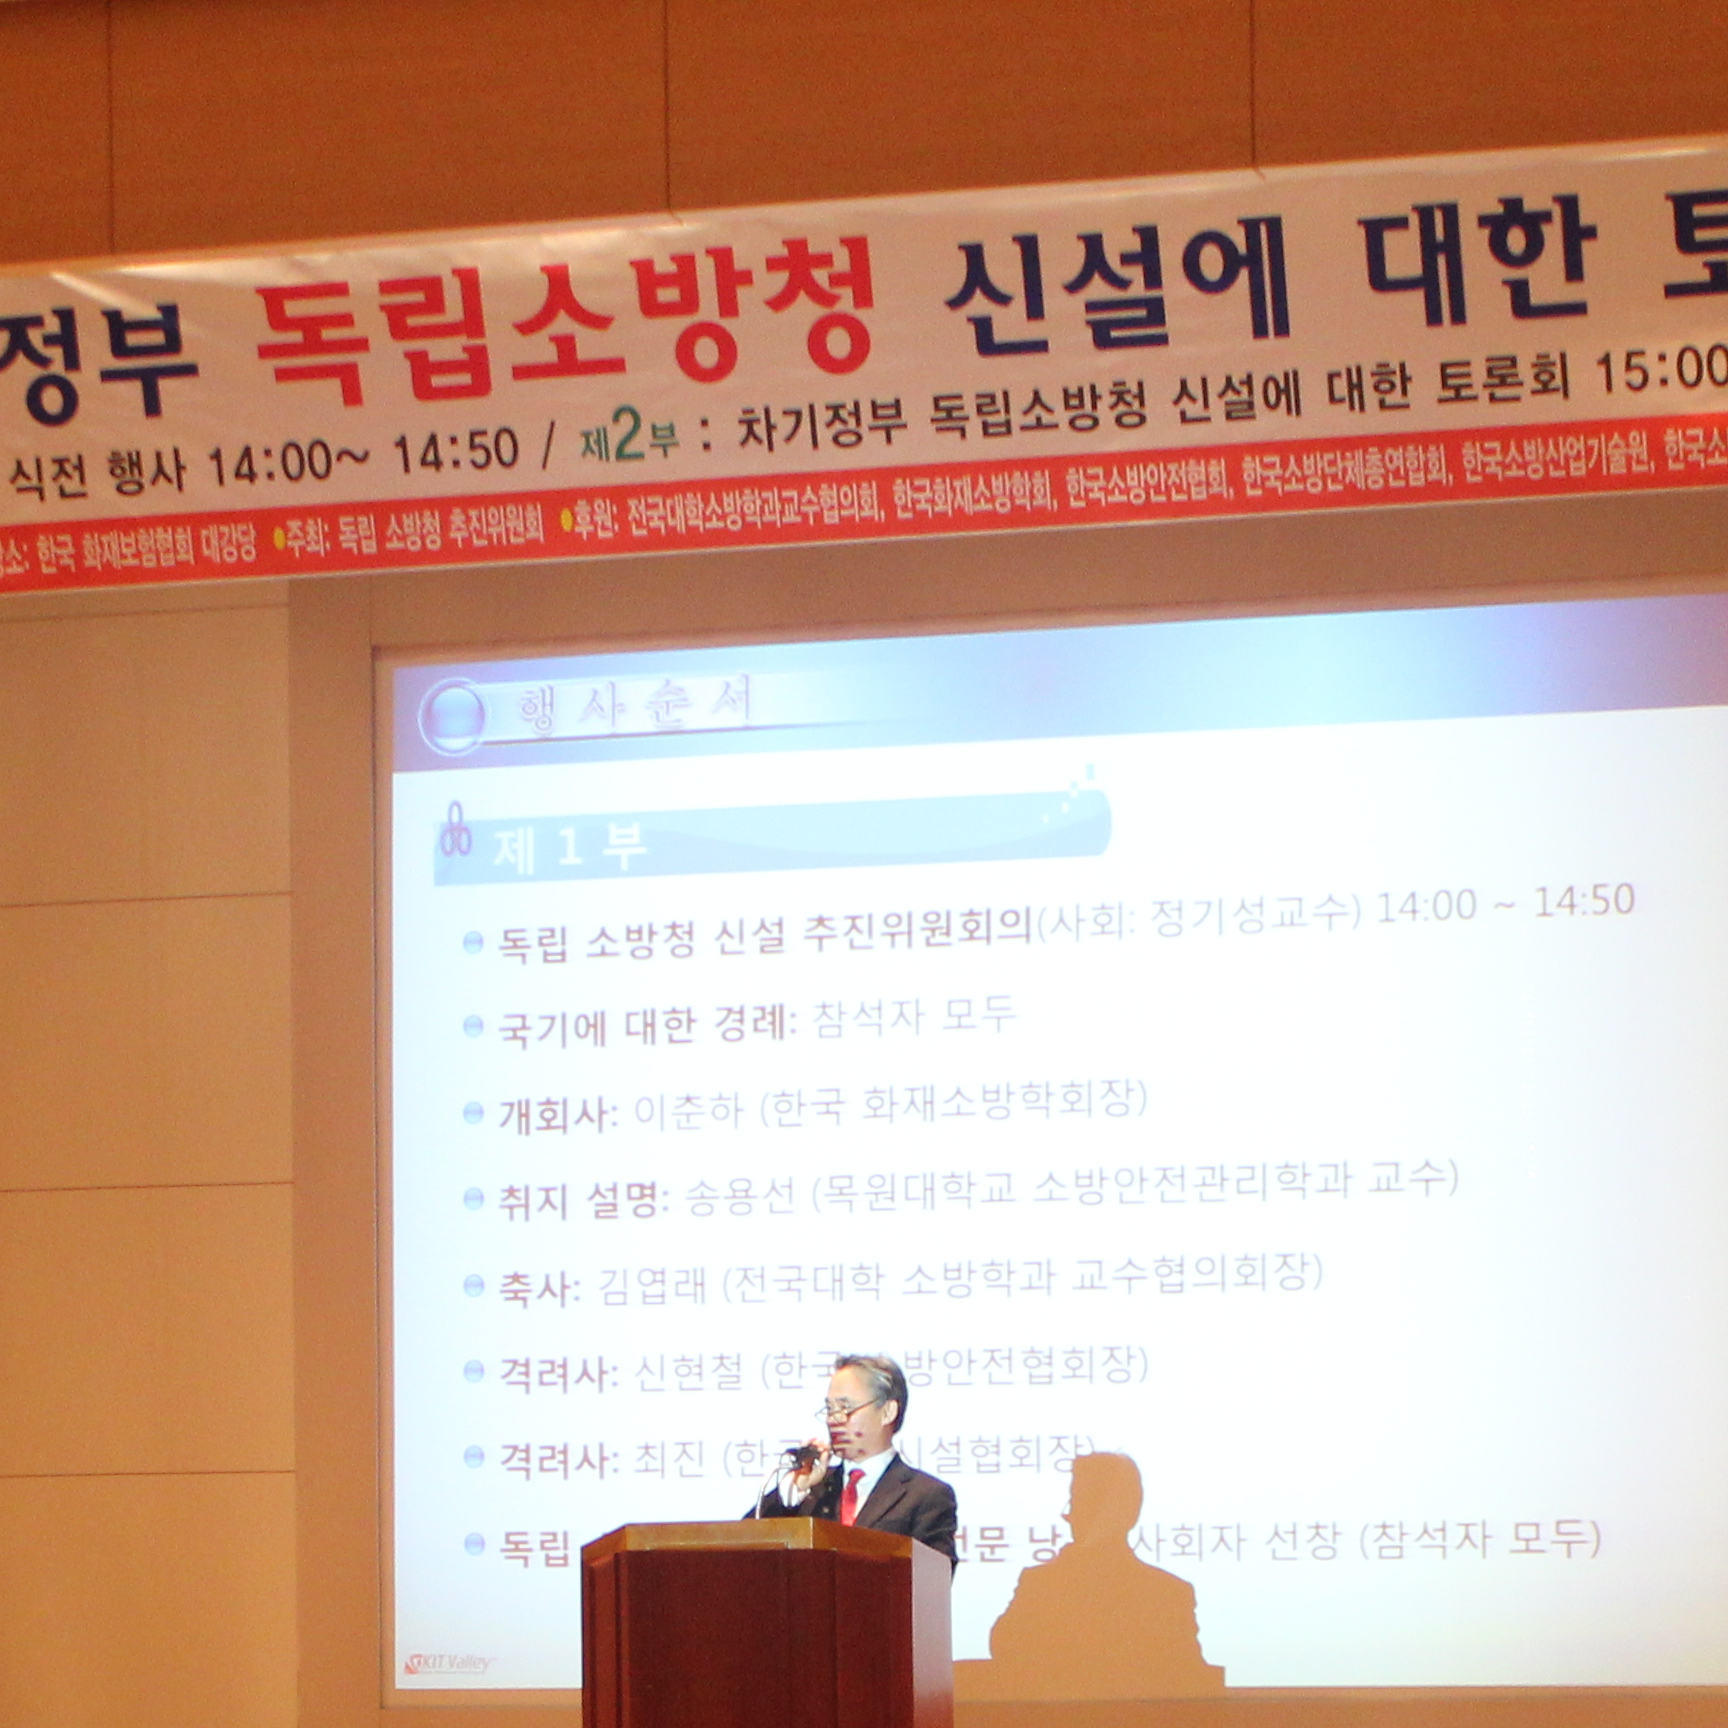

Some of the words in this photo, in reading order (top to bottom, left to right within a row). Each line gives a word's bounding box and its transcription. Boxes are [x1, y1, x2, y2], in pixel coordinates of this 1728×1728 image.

[256, 236, 876, 407] 독립소방청
[947, 216, 1289, 358] 신설에
[1364, 195, 1595, 329] 대한
[11, 456, 89, 504] 식전
[108, 450, 185, 499] 행사
[208, 438, 370, 488] 14:00~
[395, 428, 519, 475] 14:50
[582, 404, 680, 463] 제2부
[737, 396, 908, 455] 차기정부
[931, 384, 1147, 442] 독립소방청
[1173, 374, 1301, 425] 신설에
[1328, 364, 1412, 414] 대한
[1436, 352, 1569, 406] 토론회
[498, 925, 568, 965] 독립
[586, 920, 696, 960] 소방청
[714, 916, 785, 955] 신설
[1150, 892, 1362, 940] 정기성교수)
[1377, 888, 1478, 923] 14:00
[1534, 882, 1635, 918] 14:50
[498, 1012, 607, 1050] 국기에
[624, 1006, 698, 1046] 대한
[714, 1003, 797, 1043] 경례:
[812, 998, 927, 1040] 참석자
[941, 994, 1018, 1034] 모두
[498, 1096, 618, 1136] 개회사:
[634, 1090, 745, 1133] 이춘하
[759, 1086, 846, 1130] (한국
[862, 1077, 1148, 1124] 화재소방학회장)
[498, 1184, 568, 1222] 취지
[586, 1181, 669, 1220] 설명:
[685, 1176, 796, 1218] 송용선
[811, 1170, 1017, 1216] (목원대학교
[1033, 1160, 1354, 1208] 소방안전관리학과
[1368, 1158, 1460, 1200] 교수)
[498, 1270, 582, 1310] 축사:
[598, 1264, 708, 1306] 김엽래
[722, 1259, 887, 1304] (전국대학
[902, 1256, 1057, 1300] 소방학과
[1072, 1250, 1324, 1296] 교수협의회장)
[498, 1356, 618, 1396] 격려사:
[634, 1350, 744, 1392] 신현철
[761, 1344, 1149, 1390] (한국방안전협회장)
[498, 1442, 618, 1482] 격려사:
[634, 1437, 705, 1479] 최진
[498, 1529, 570, 1570] 독립
[1269, 1520, 1342, 1562] 선창
[1358, 1518, 1492, 1562] (참석자
[1508, 1516, 1602, 1560] 모두)
